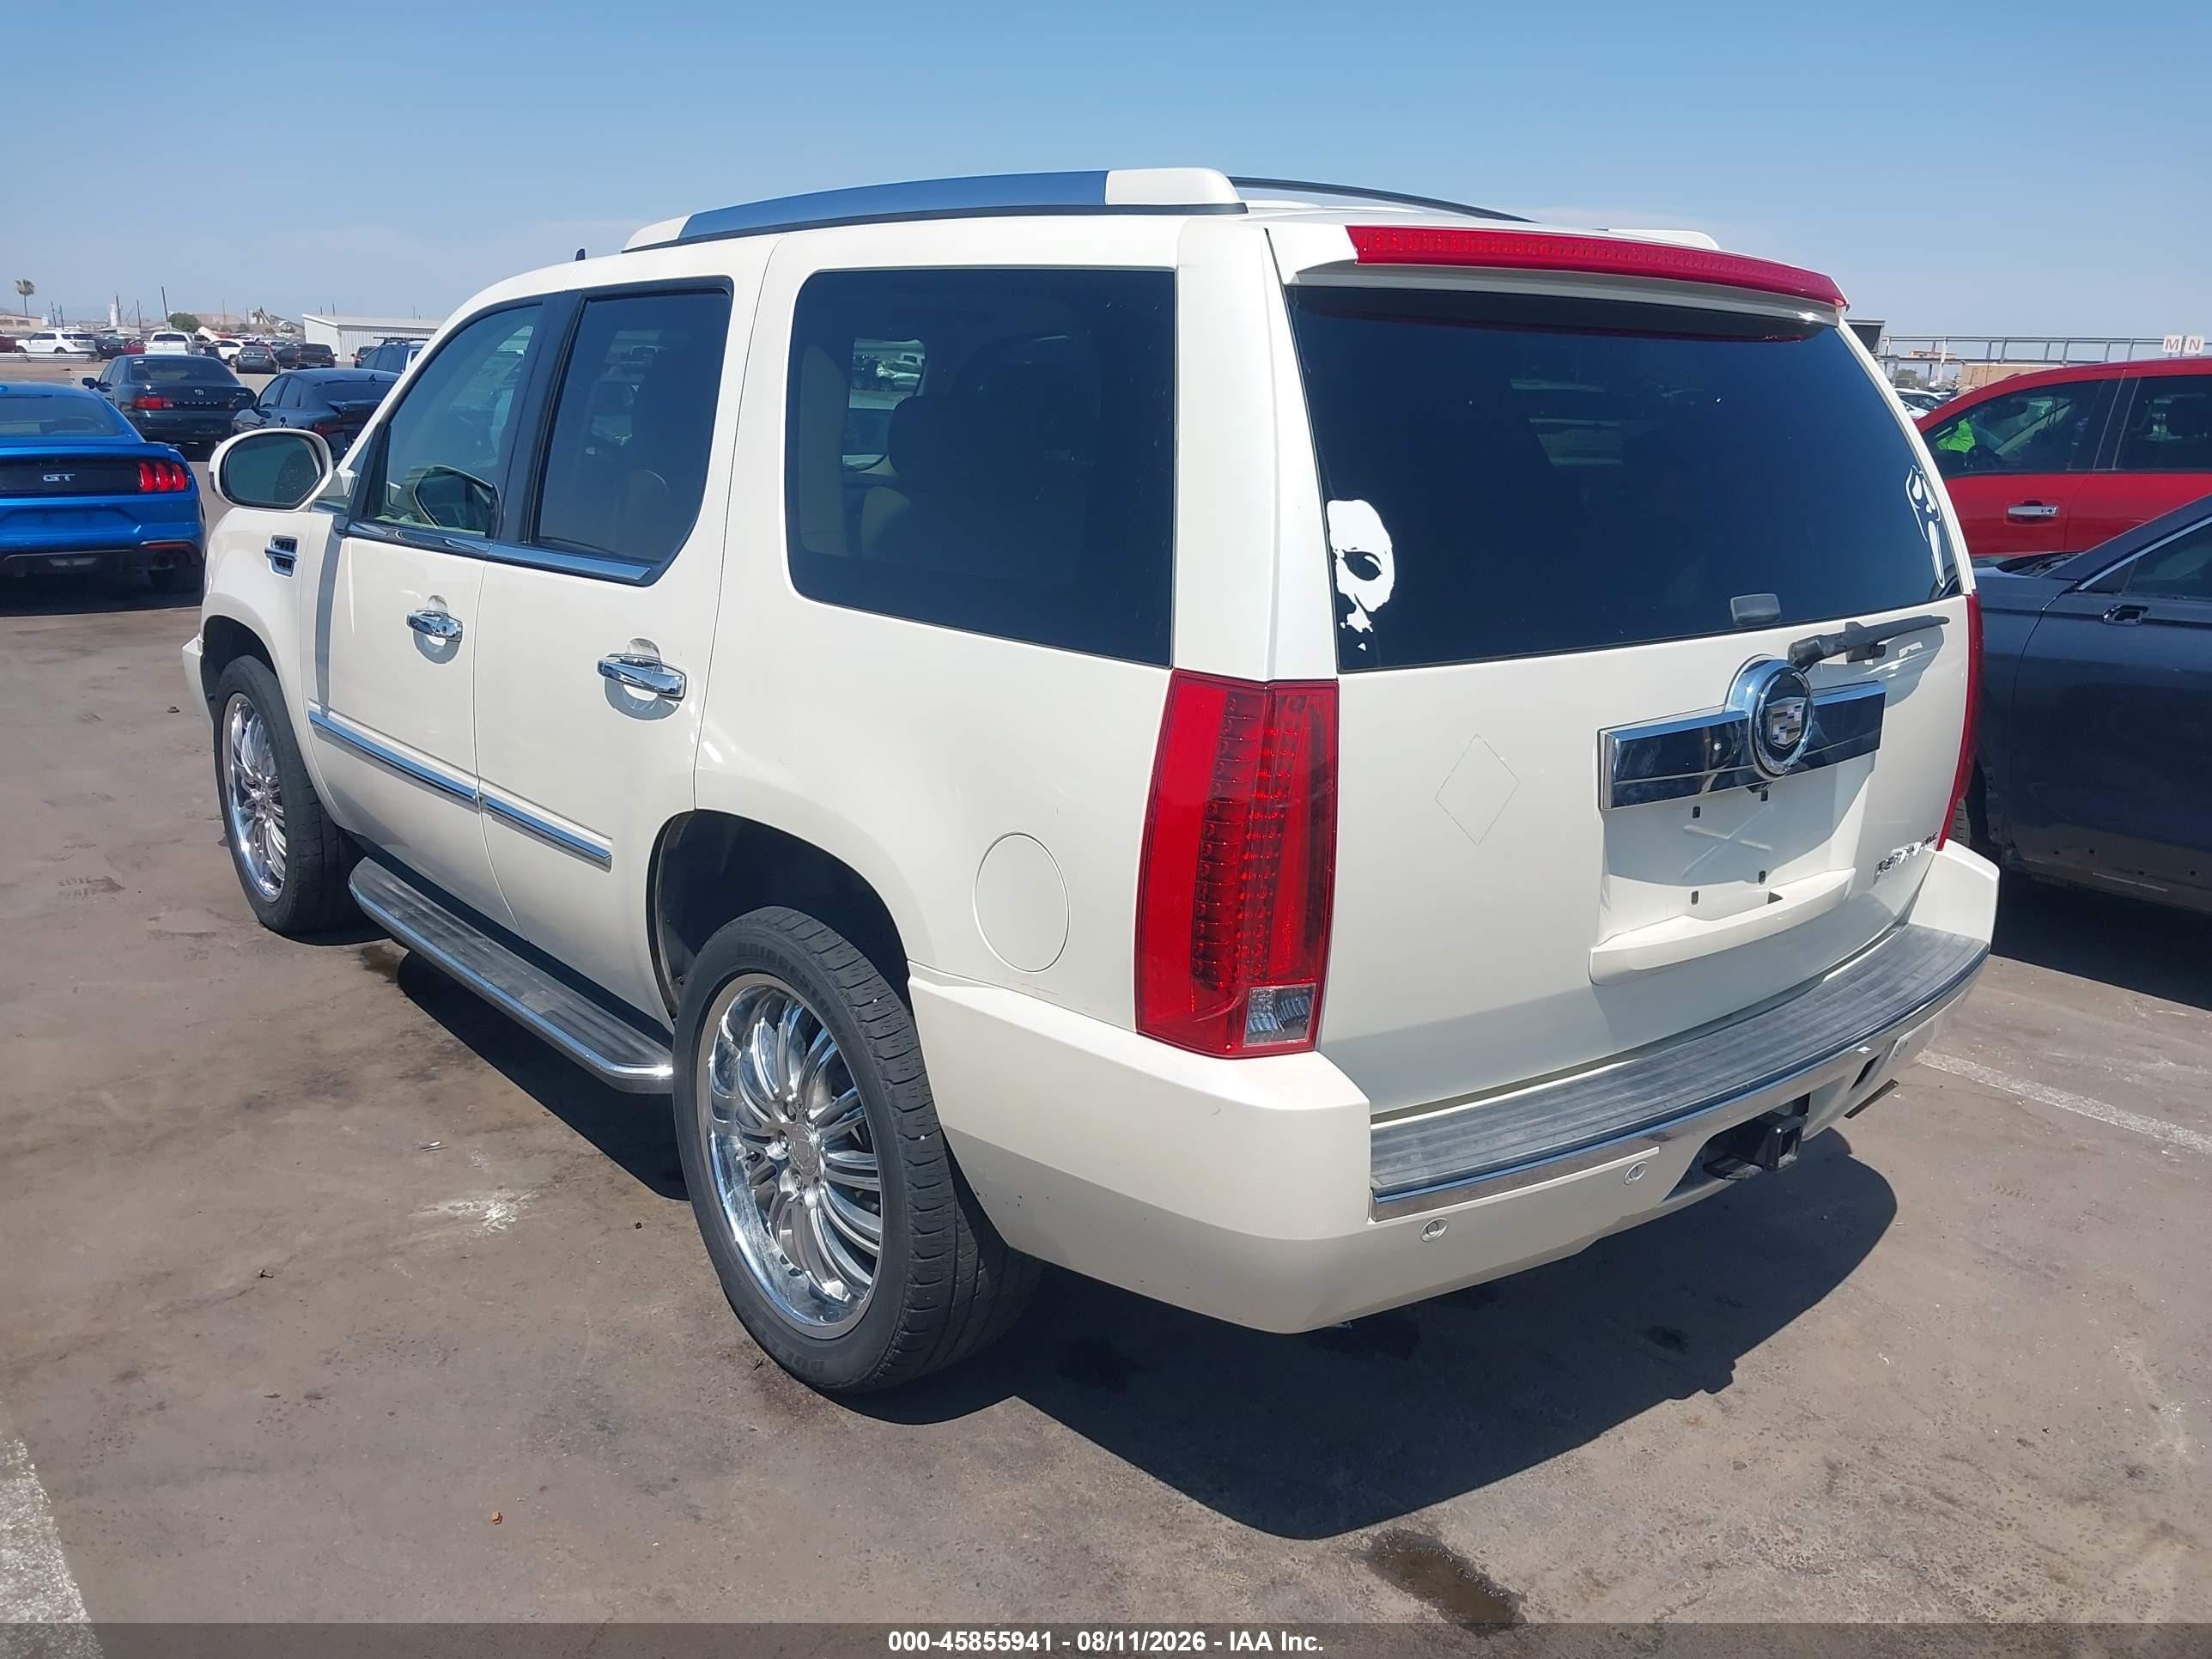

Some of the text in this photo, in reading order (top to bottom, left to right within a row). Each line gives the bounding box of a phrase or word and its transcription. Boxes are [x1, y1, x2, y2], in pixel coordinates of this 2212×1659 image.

[2165, 338, 2179, 350] M
[2189, 338, 2201, 351] N
[43, 473, 76, 482] GT
